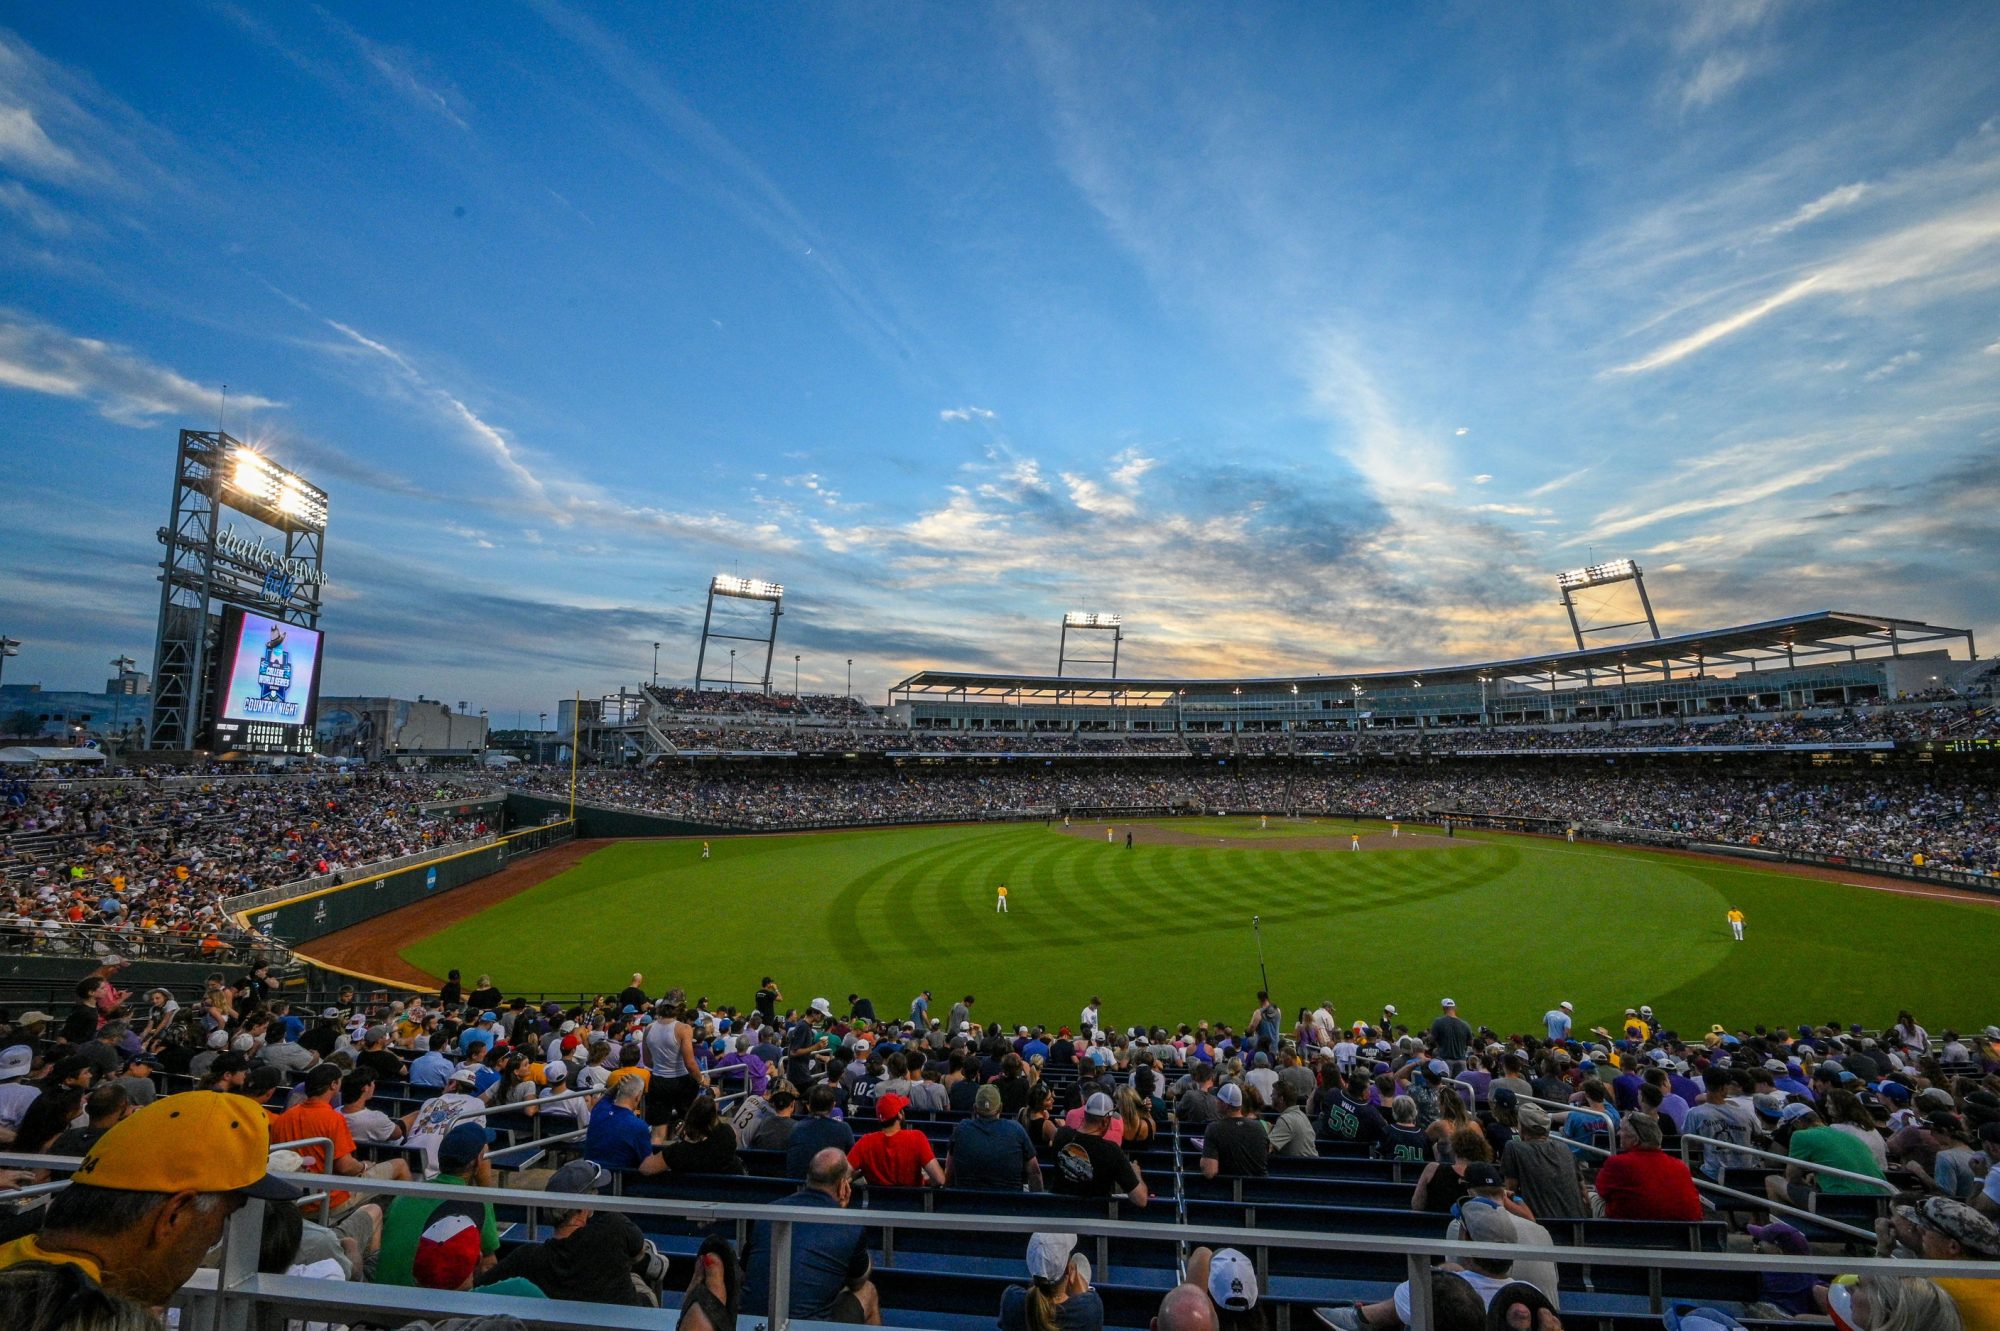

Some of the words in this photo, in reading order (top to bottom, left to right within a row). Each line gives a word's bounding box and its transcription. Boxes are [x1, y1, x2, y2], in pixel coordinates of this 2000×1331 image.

[279, 555, 328, 587] SCHWAB
[265, 594, 289, 607] OMAHA
[243, 698, 277, 713] COUNTRY
[278, 702, 298, 716] NIGHT
[733, 1107, 753, 1129] 13
[1328, 1104, 1359, 1138] 59
